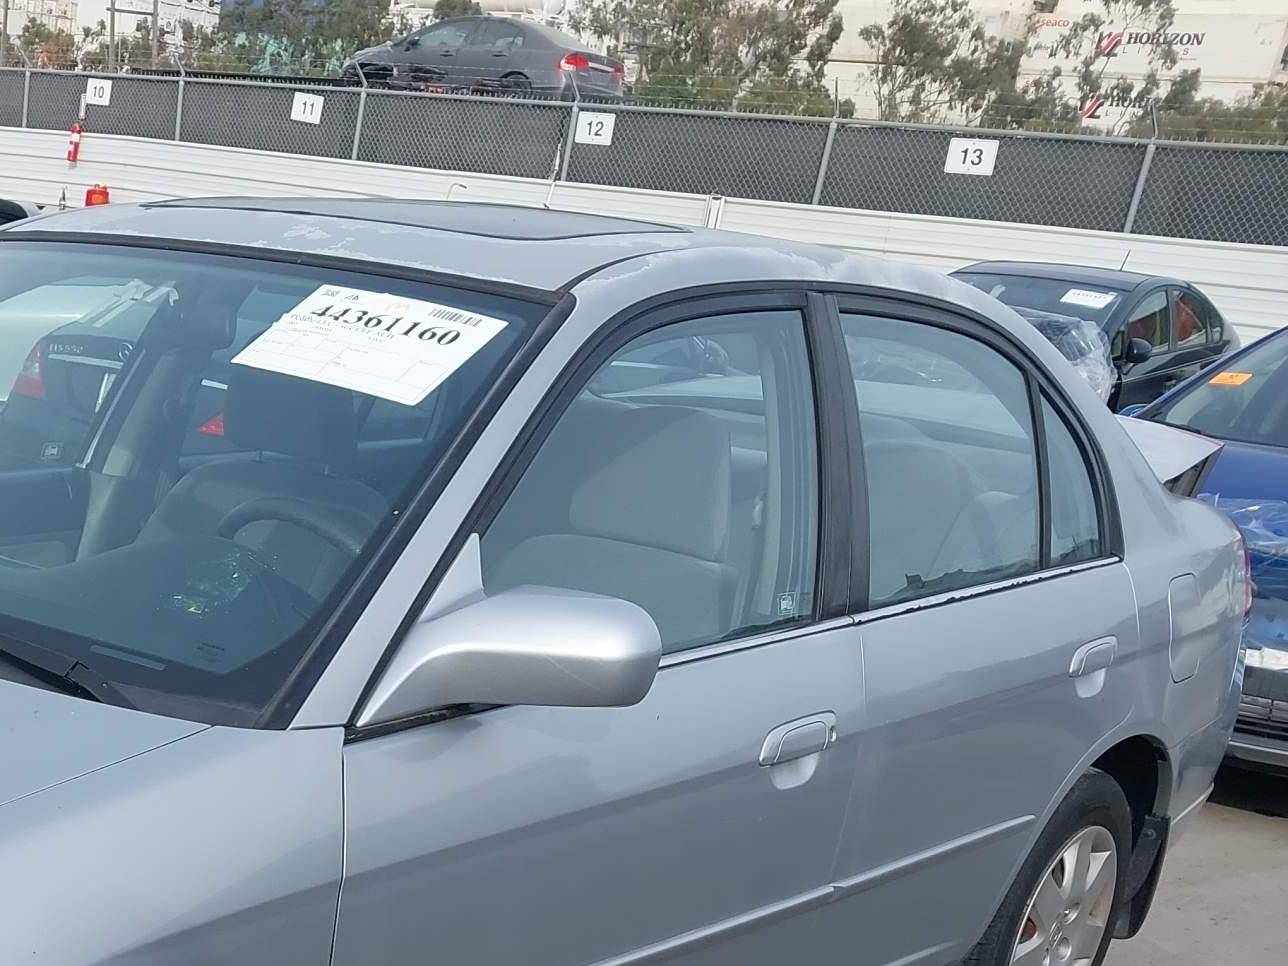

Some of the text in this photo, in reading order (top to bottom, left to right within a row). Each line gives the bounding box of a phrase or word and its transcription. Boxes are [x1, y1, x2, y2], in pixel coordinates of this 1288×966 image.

[1040, 18, 1070, 28] seaco
[1126, 32, 1205, 46] HORIZON
[93, 85, 105, 99] 10
[302, 100, 315, 116] 11
[587, 120, 604, 137] 12
[961, 147, 984, 166] 13
[311, 304, 461, 346] 44361160
